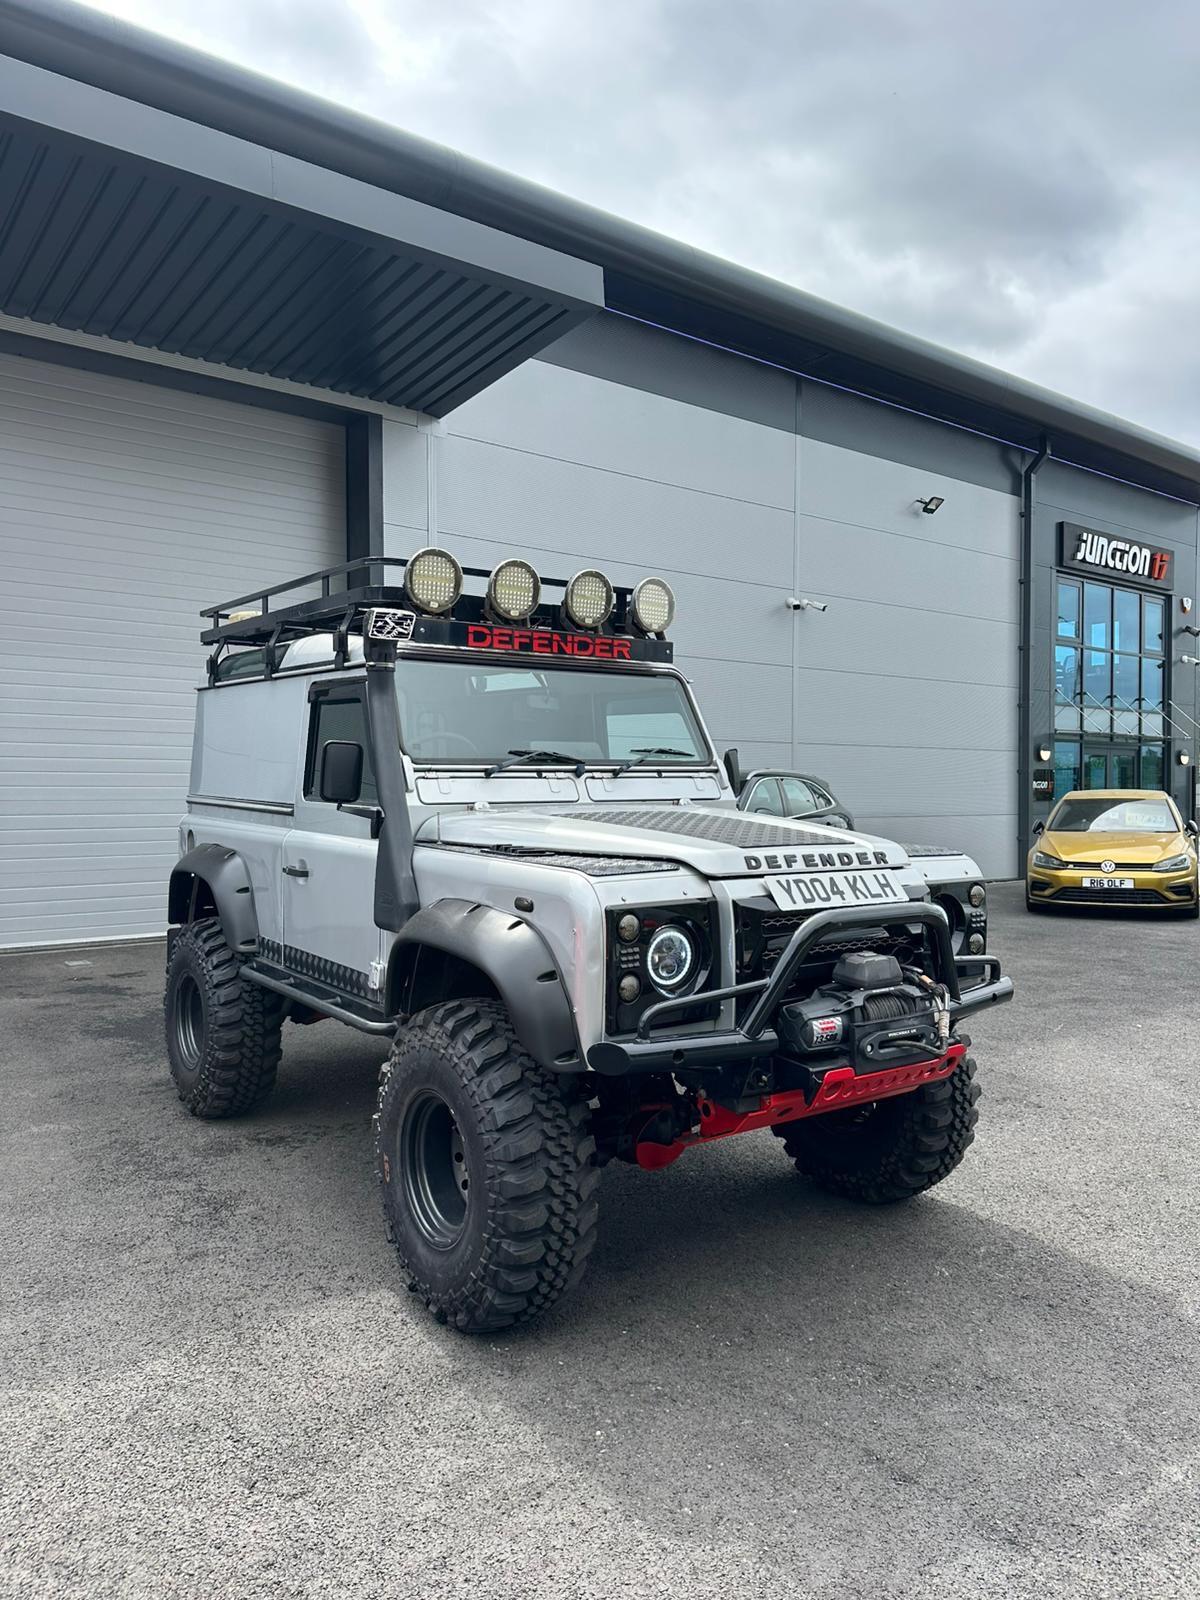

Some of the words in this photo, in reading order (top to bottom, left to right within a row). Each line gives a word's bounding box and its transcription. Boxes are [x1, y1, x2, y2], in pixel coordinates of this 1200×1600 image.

[467, 626, 631, 660] DEFENDER
[744, 851, 889, 870] DEFENDER
[776, 876, 845, 905] YD04
[844, 873, 898, 900] KLH
[1090, 878, 1105, 888] R16
[1106, 879, 1125, 888] OLF
